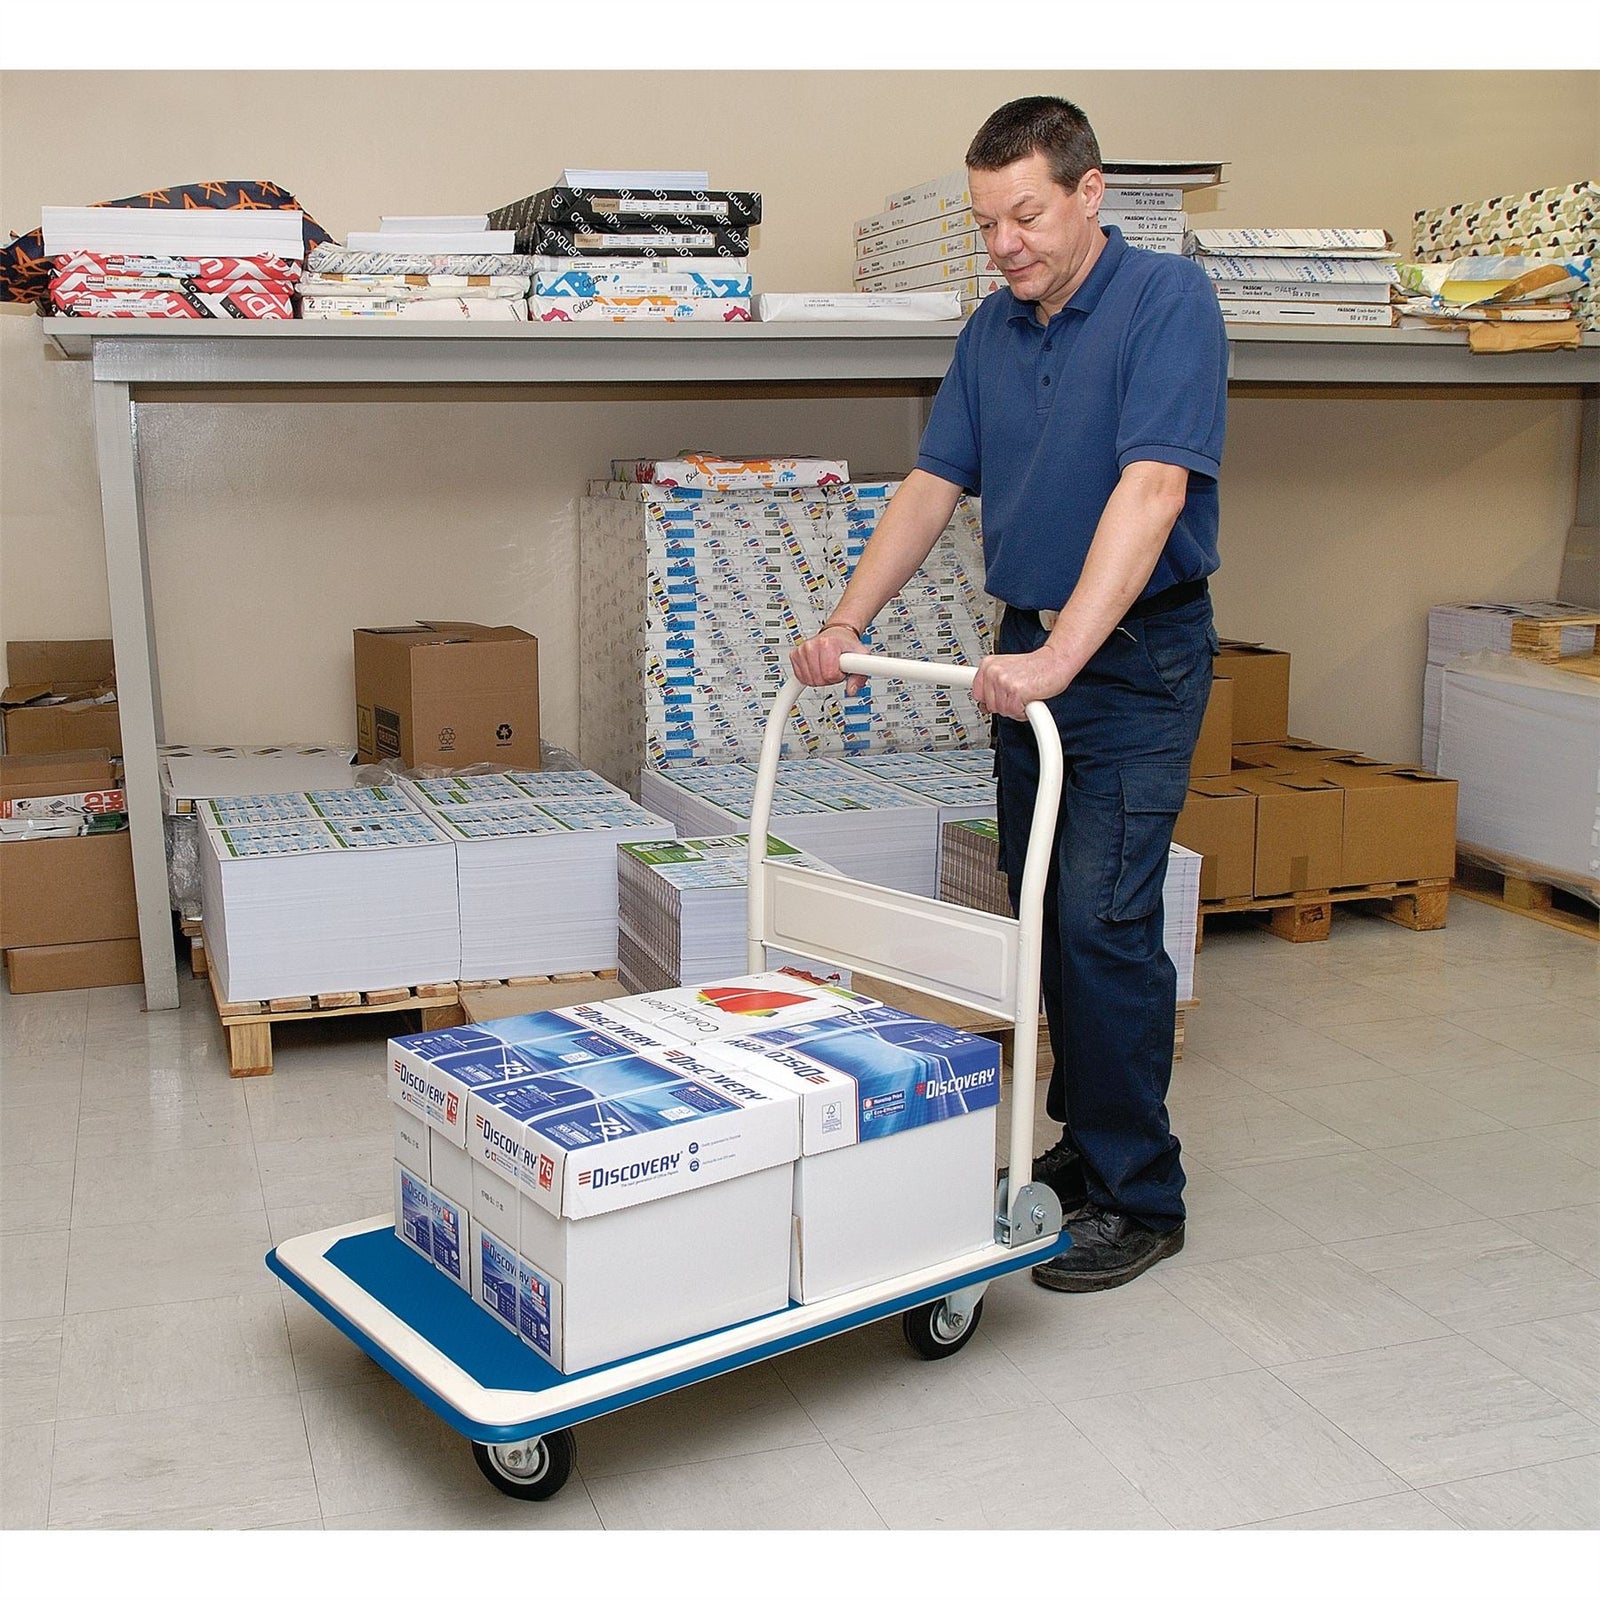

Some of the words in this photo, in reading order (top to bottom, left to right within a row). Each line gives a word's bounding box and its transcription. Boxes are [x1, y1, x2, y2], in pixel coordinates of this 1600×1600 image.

[575, 1010, 662, 1046] DISCOVERY
[926, 1067, 996, 1100] DISCOVERY
[540, 1158, 552, 1180] 75
[592, 1152, 681, 1190] DISCOVERY
